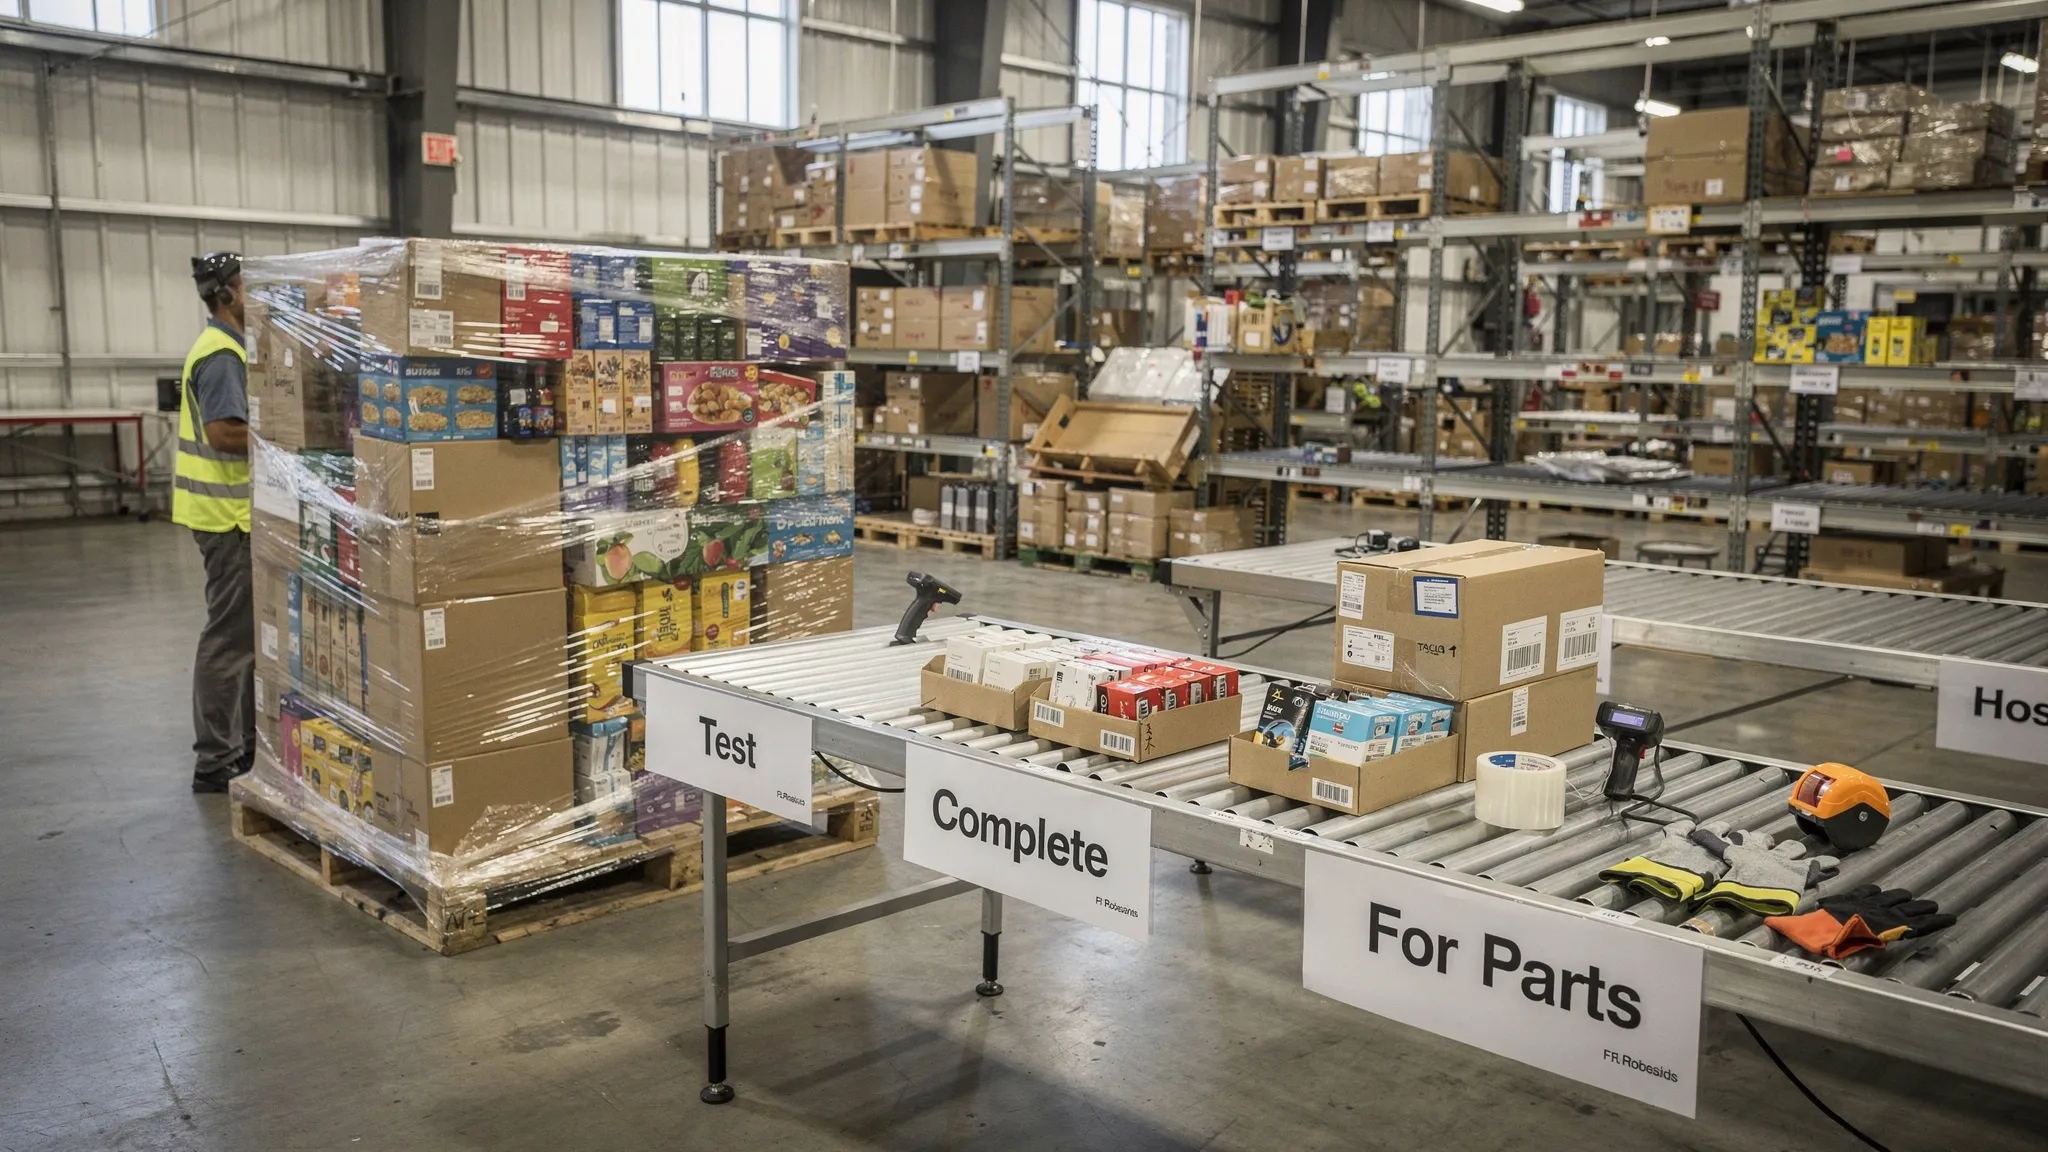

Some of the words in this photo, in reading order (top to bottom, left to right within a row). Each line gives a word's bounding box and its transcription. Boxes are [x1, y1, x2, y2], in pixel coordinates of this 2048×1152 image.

[699, 715, 757, 769] Test
[1974, 686, 2048, 726] Hos
[932, 788, 1108, 878] Complete
[1369, 901, 1459, 975] For
[1482, 932, 1642, 1030] Parts
